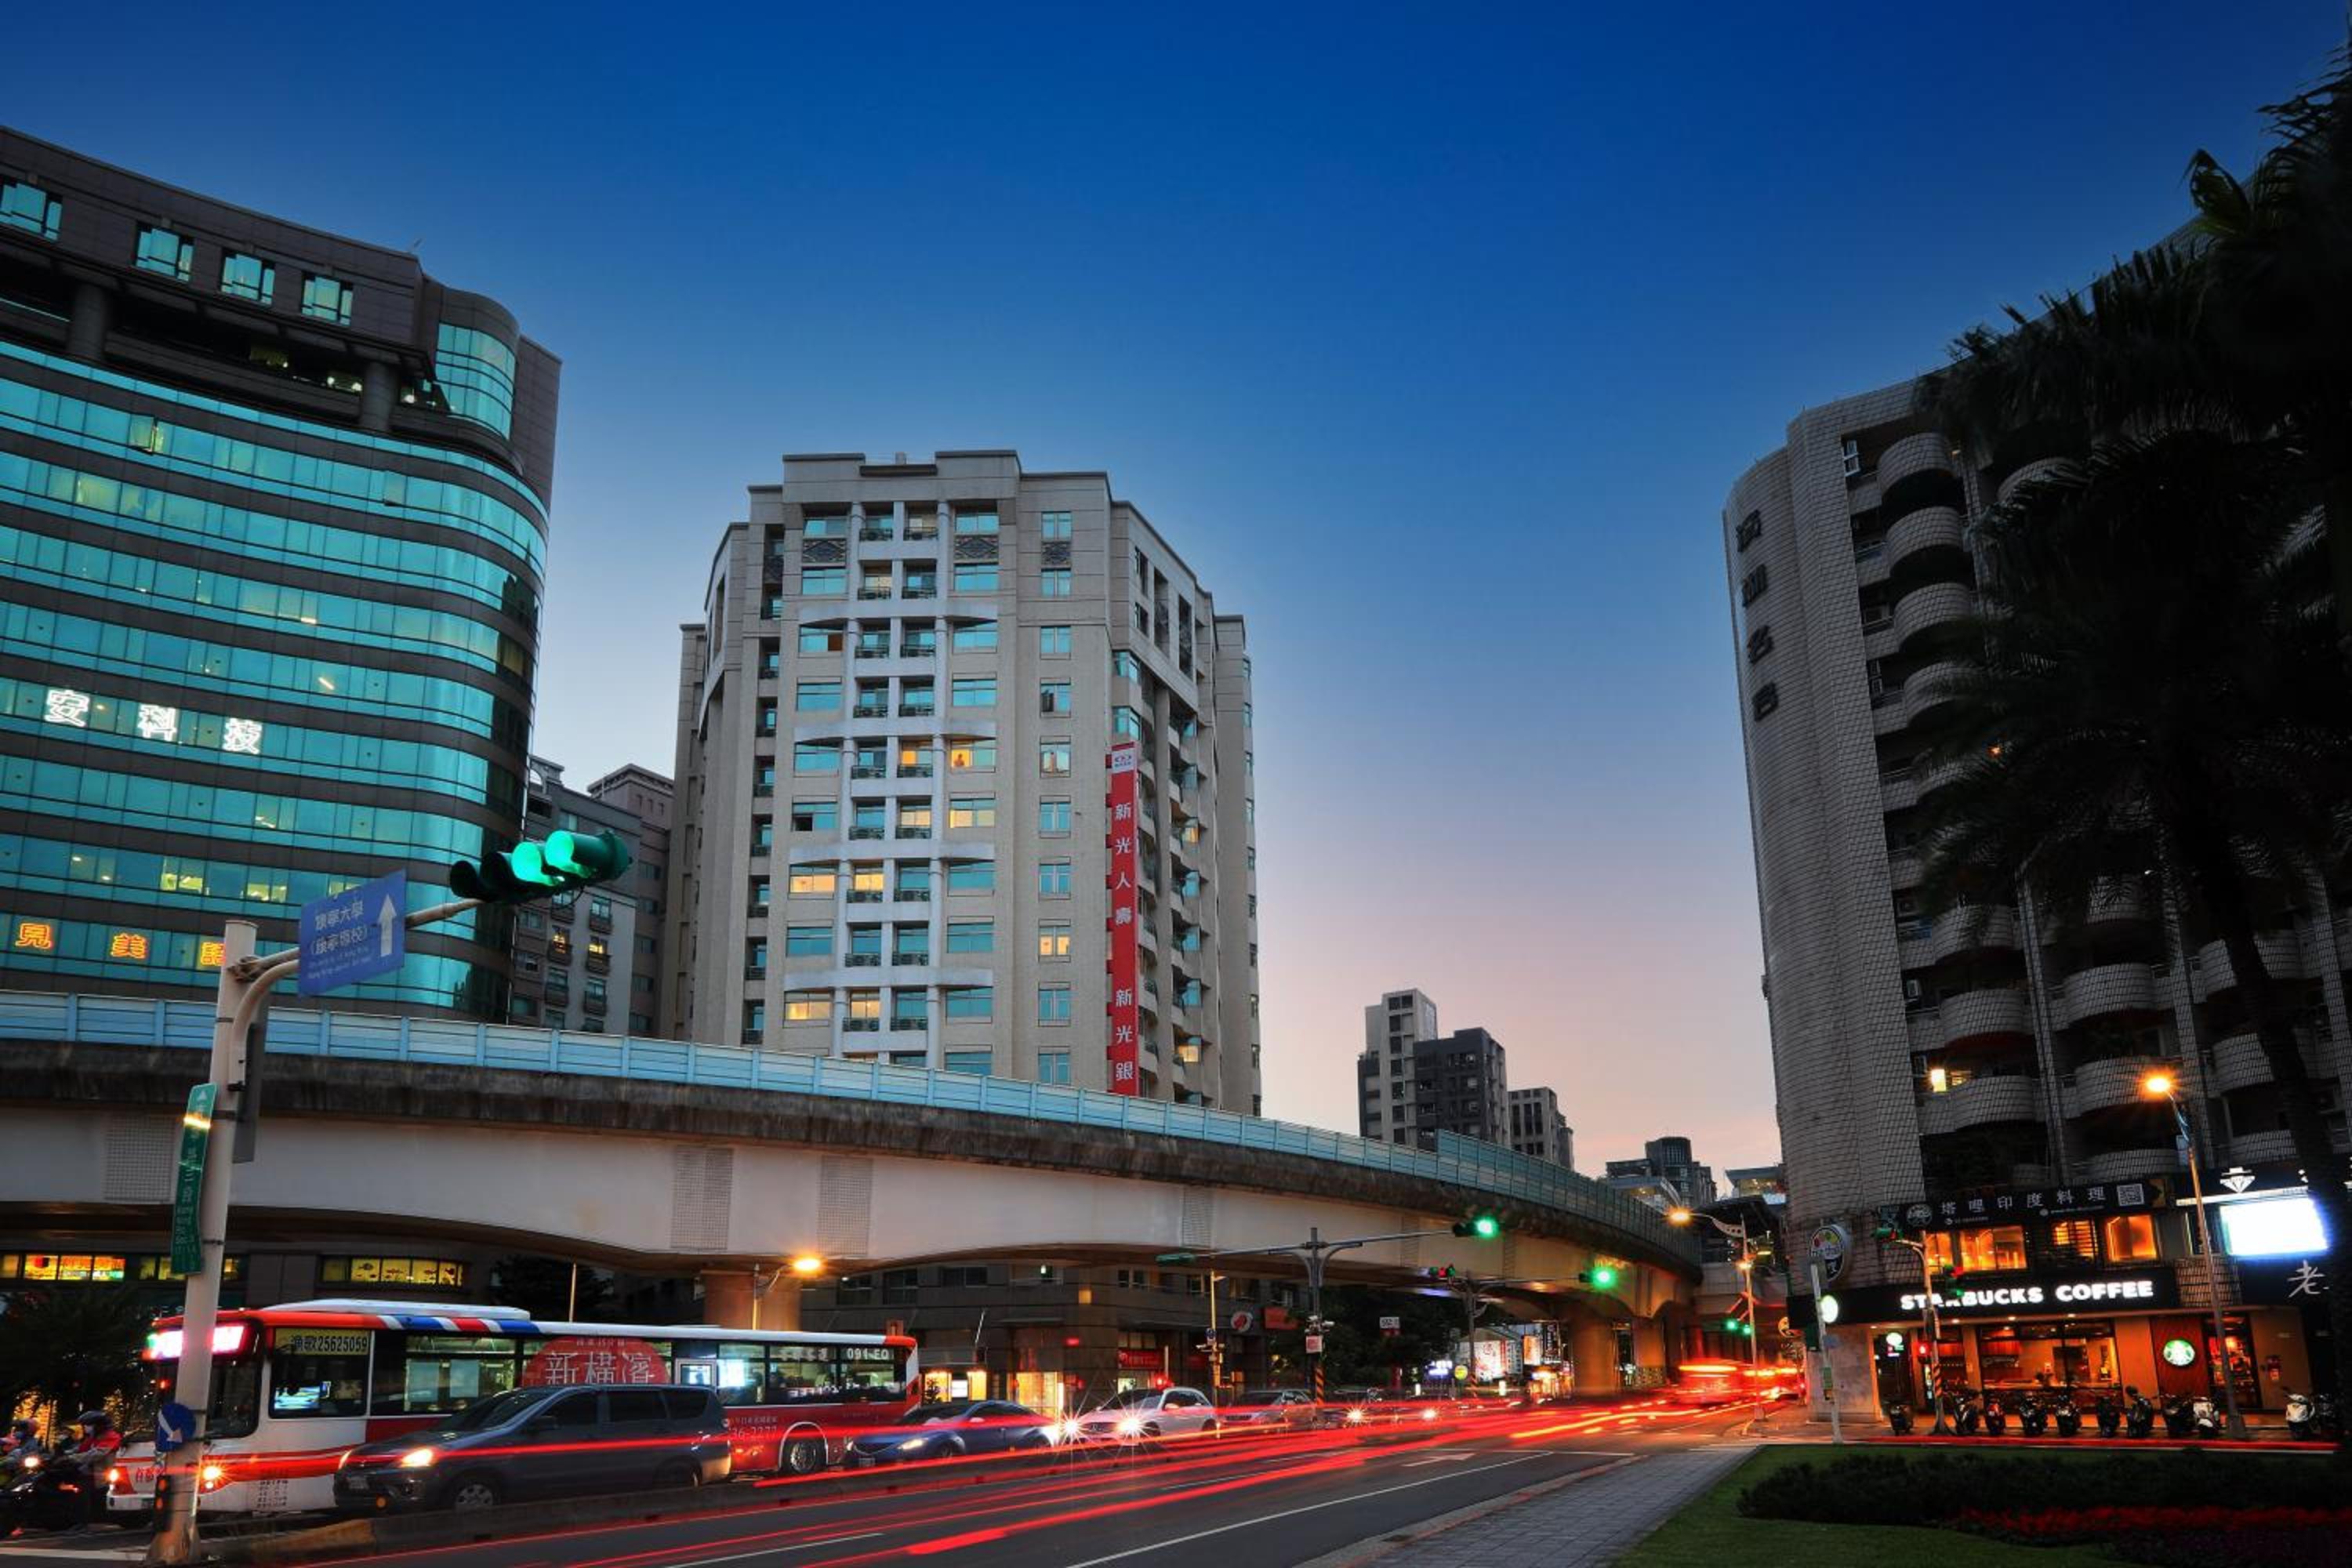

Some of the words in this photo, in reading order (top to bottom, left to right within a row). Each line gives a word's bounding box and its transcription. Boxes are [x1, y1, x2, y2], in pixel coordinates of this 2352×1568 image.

[45, 690, 263, 754] 安科技
[1115, 803, 1132, 925] 新光人壽
[1115, 989, 1133, 1080] 新光銀
[2055, 1280, 2154, 1302] COFFEE
[2287, 1259, 2330, 1298] 老
